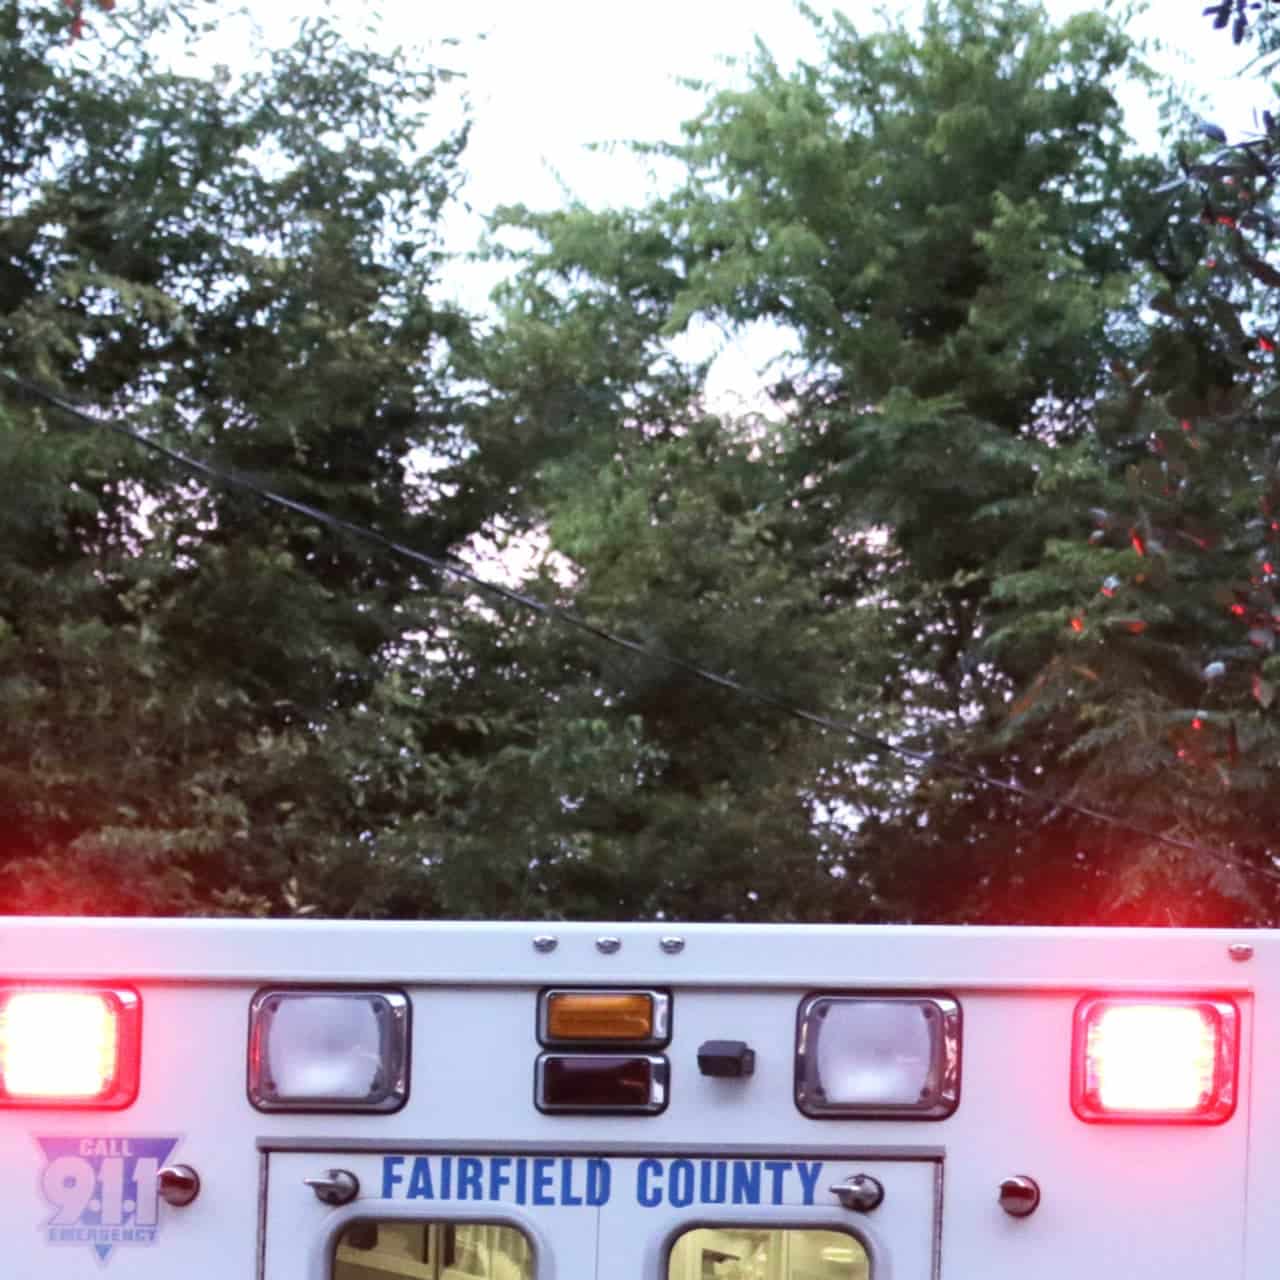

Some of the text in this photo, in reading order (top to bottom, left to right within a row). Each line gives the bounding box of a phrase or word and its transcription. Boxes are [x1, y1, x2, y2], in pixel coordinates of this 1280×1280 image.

[79, 1139, 133, 1157] CALL
[382, 1156, 823, 1209] FAIRFIELD COUNTY
